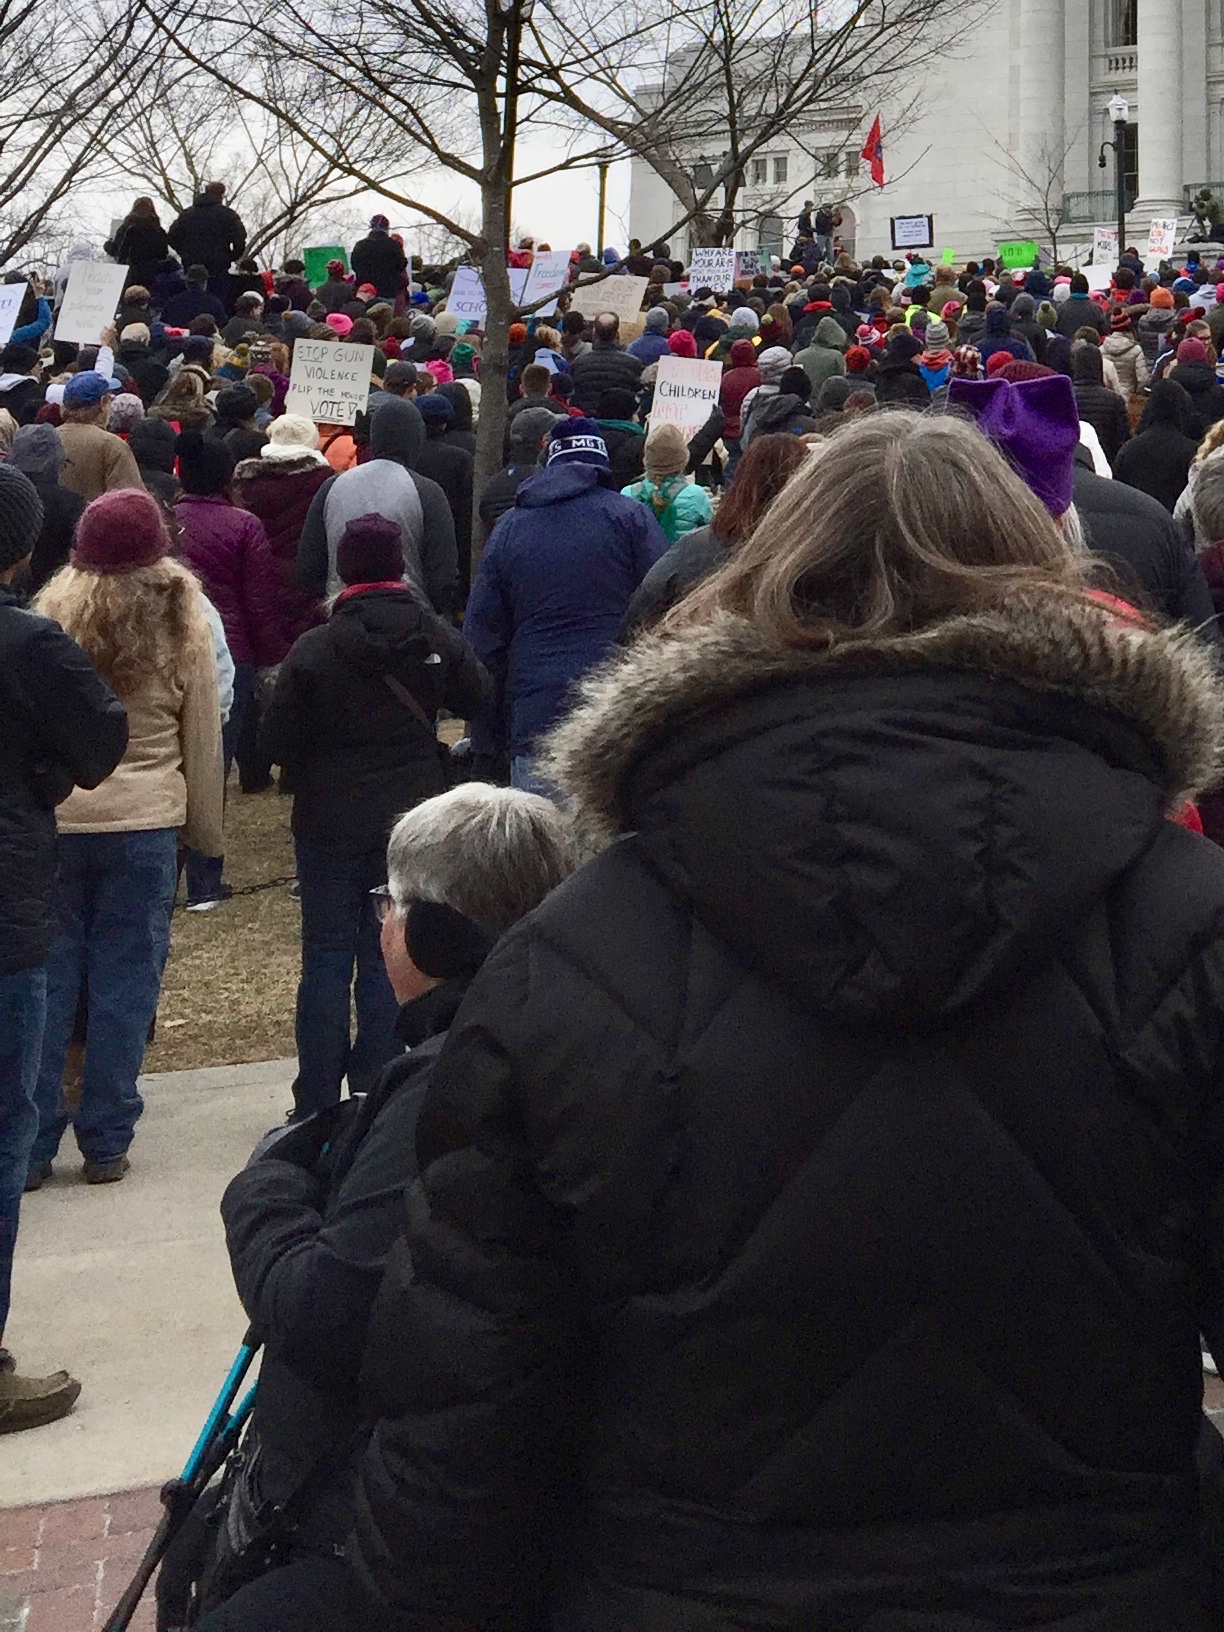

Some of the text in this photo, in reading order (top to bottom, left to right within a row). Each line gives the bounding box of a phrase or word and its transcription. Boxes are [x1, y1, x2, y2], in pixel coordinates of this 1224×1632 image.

[695, 248, 733, 257] WHY ARE
[693, 258, 714, 269] YOUR
[692, 274, 731, 284] THAN OUR
[298, 346, 364, 363] STOP GUN
[304, 365, 358, 381] VIOLENCE
[291, 383, 313, 394] FLIP
[317, 387, 335, 397] THE
[660, 380, 716, 400] CHILDREN
